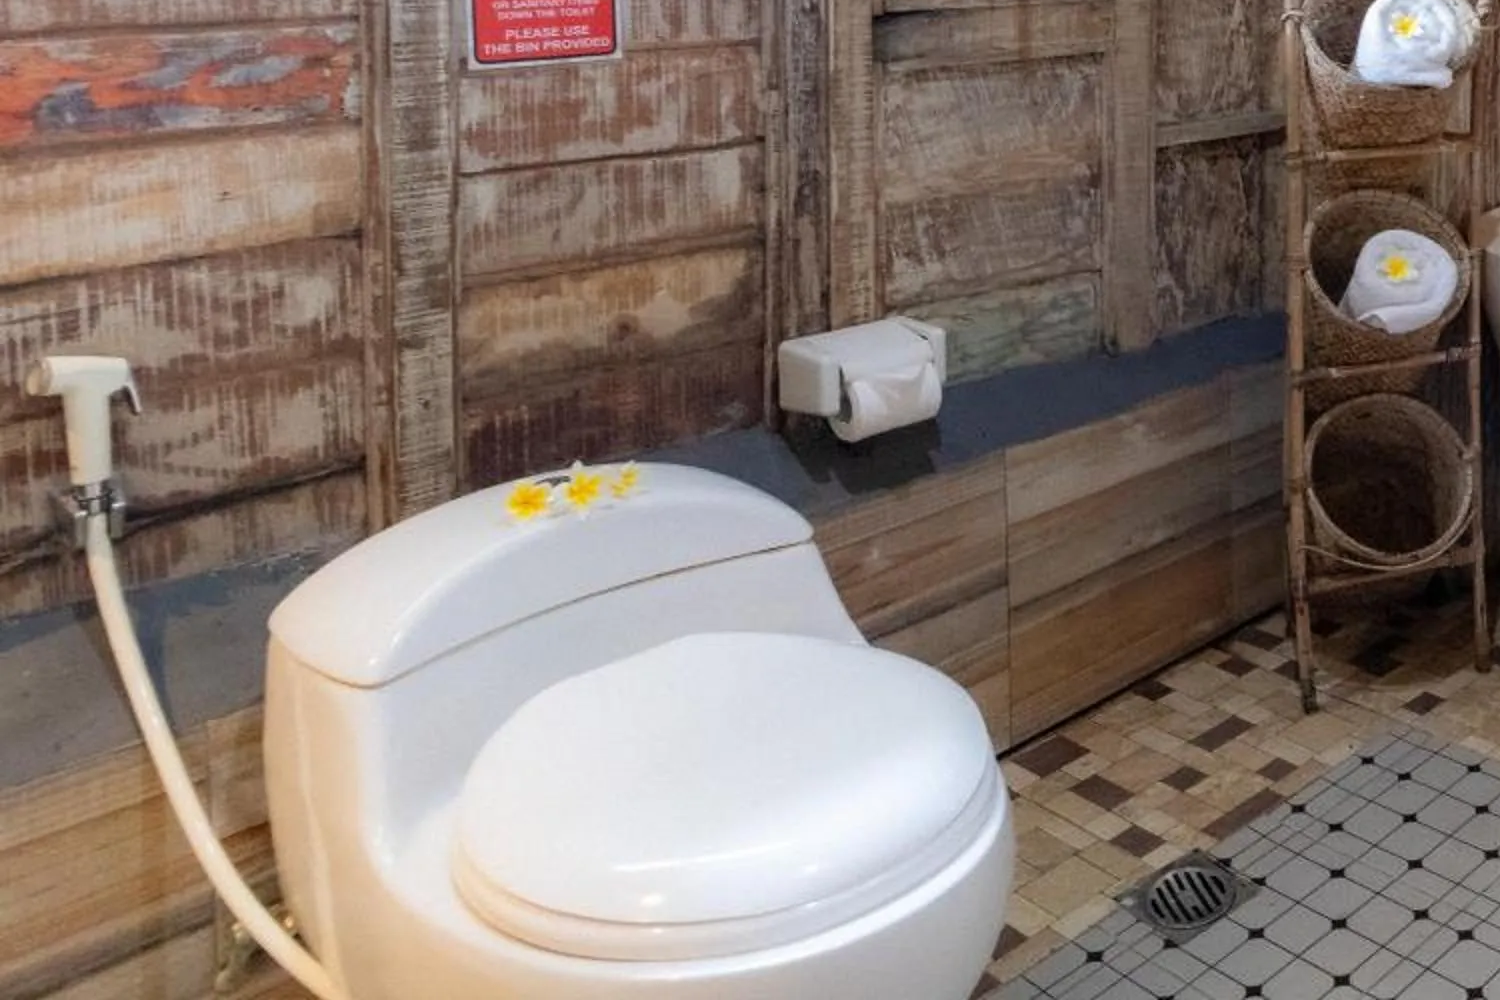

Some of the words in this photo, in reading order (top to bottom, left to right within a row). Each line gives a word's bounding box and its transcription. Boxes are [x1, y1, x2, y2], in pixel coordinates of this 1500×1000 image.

[505, 27, 560, 40] PLEASE
[563, 25, 590, 37] USE
[484, 42, 513, 56] THE
[515, 40, 540, 53] BIN
[543, 36, 610, 51] PROVIDED
